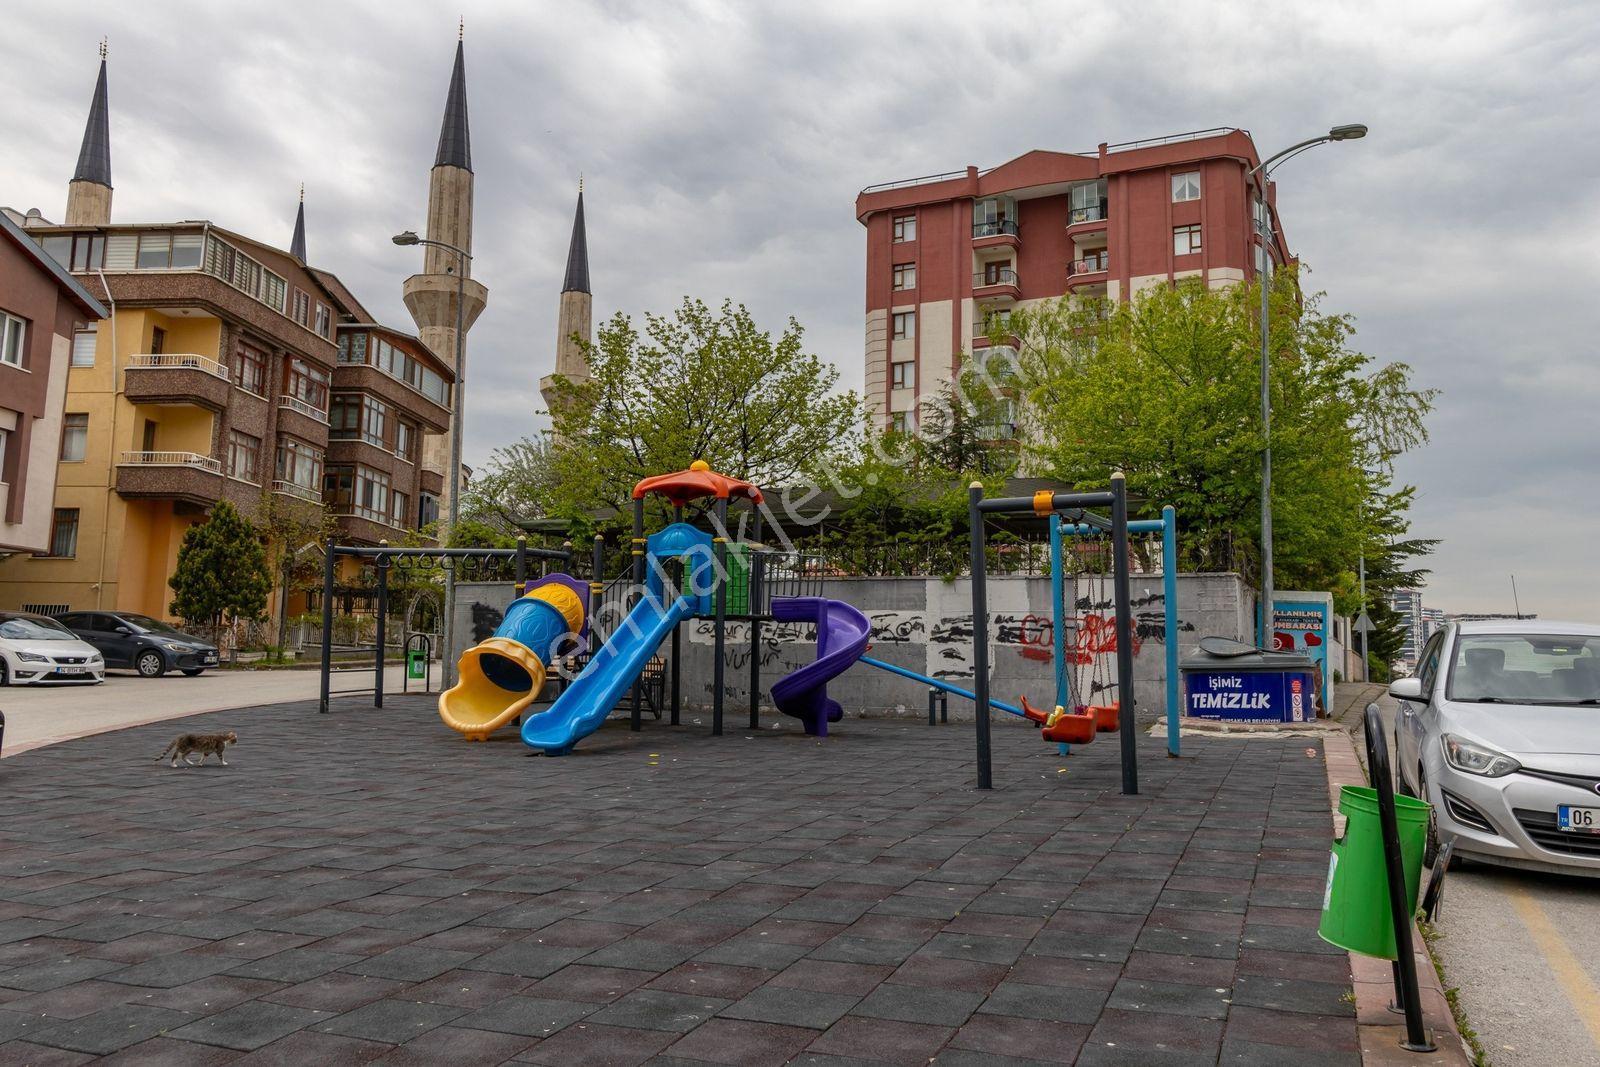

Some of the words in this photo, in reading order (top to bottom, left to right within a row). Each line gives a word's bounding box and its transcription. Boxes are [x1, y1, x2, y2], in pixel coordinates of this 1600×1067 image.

[1272, 610, 1323, 618] ULLANILMIŞ
[1209, 676, 1242, 690] İŞİMİZ
[1573, 810, 1592, 825] 06
